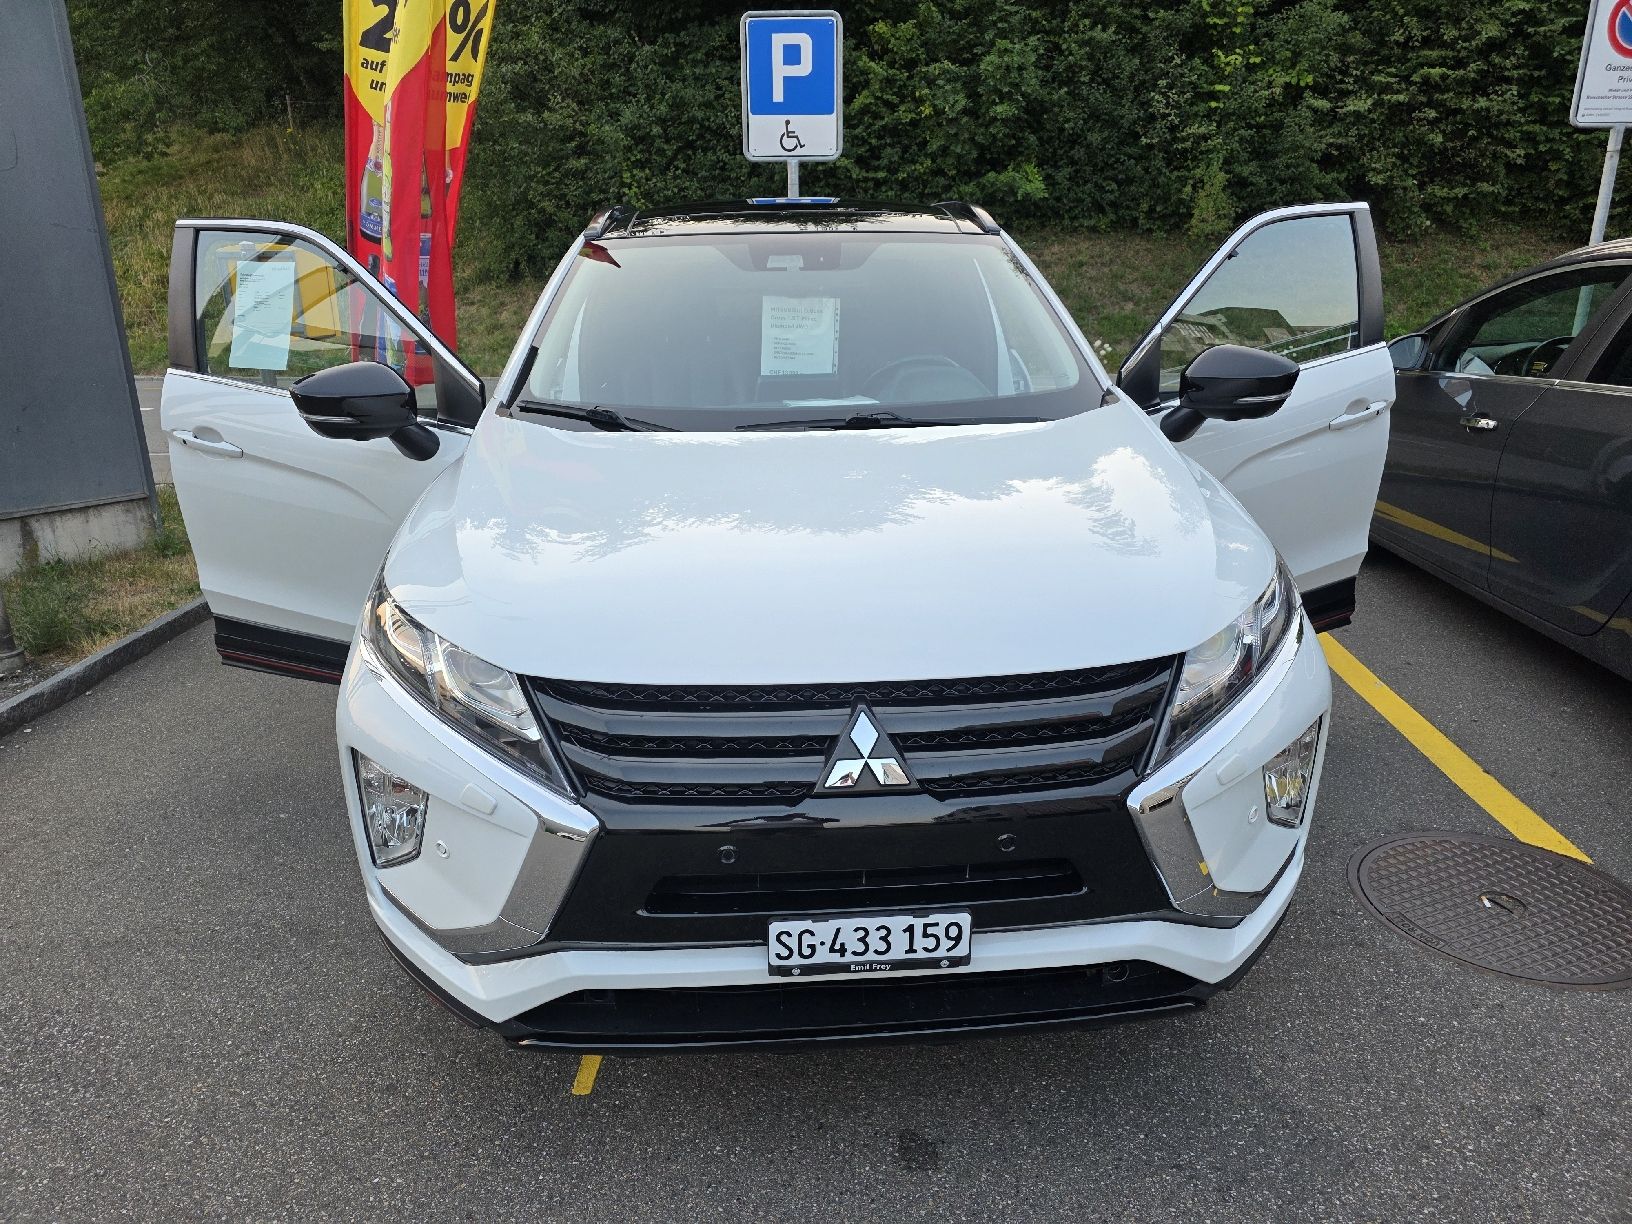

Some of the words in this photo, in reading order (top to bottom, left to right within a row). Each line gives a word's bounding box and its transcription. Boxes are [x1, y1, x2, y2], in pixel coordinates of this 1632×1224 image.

[361, 57, 387, 73] auf
[772, 33, 812, 102] P
[370, 79, 386, 93] un
[1618, 75, 1632, 83] Priv
[850, 963, 870, 971] Emil
[872, 963, 892, 971] Frey
